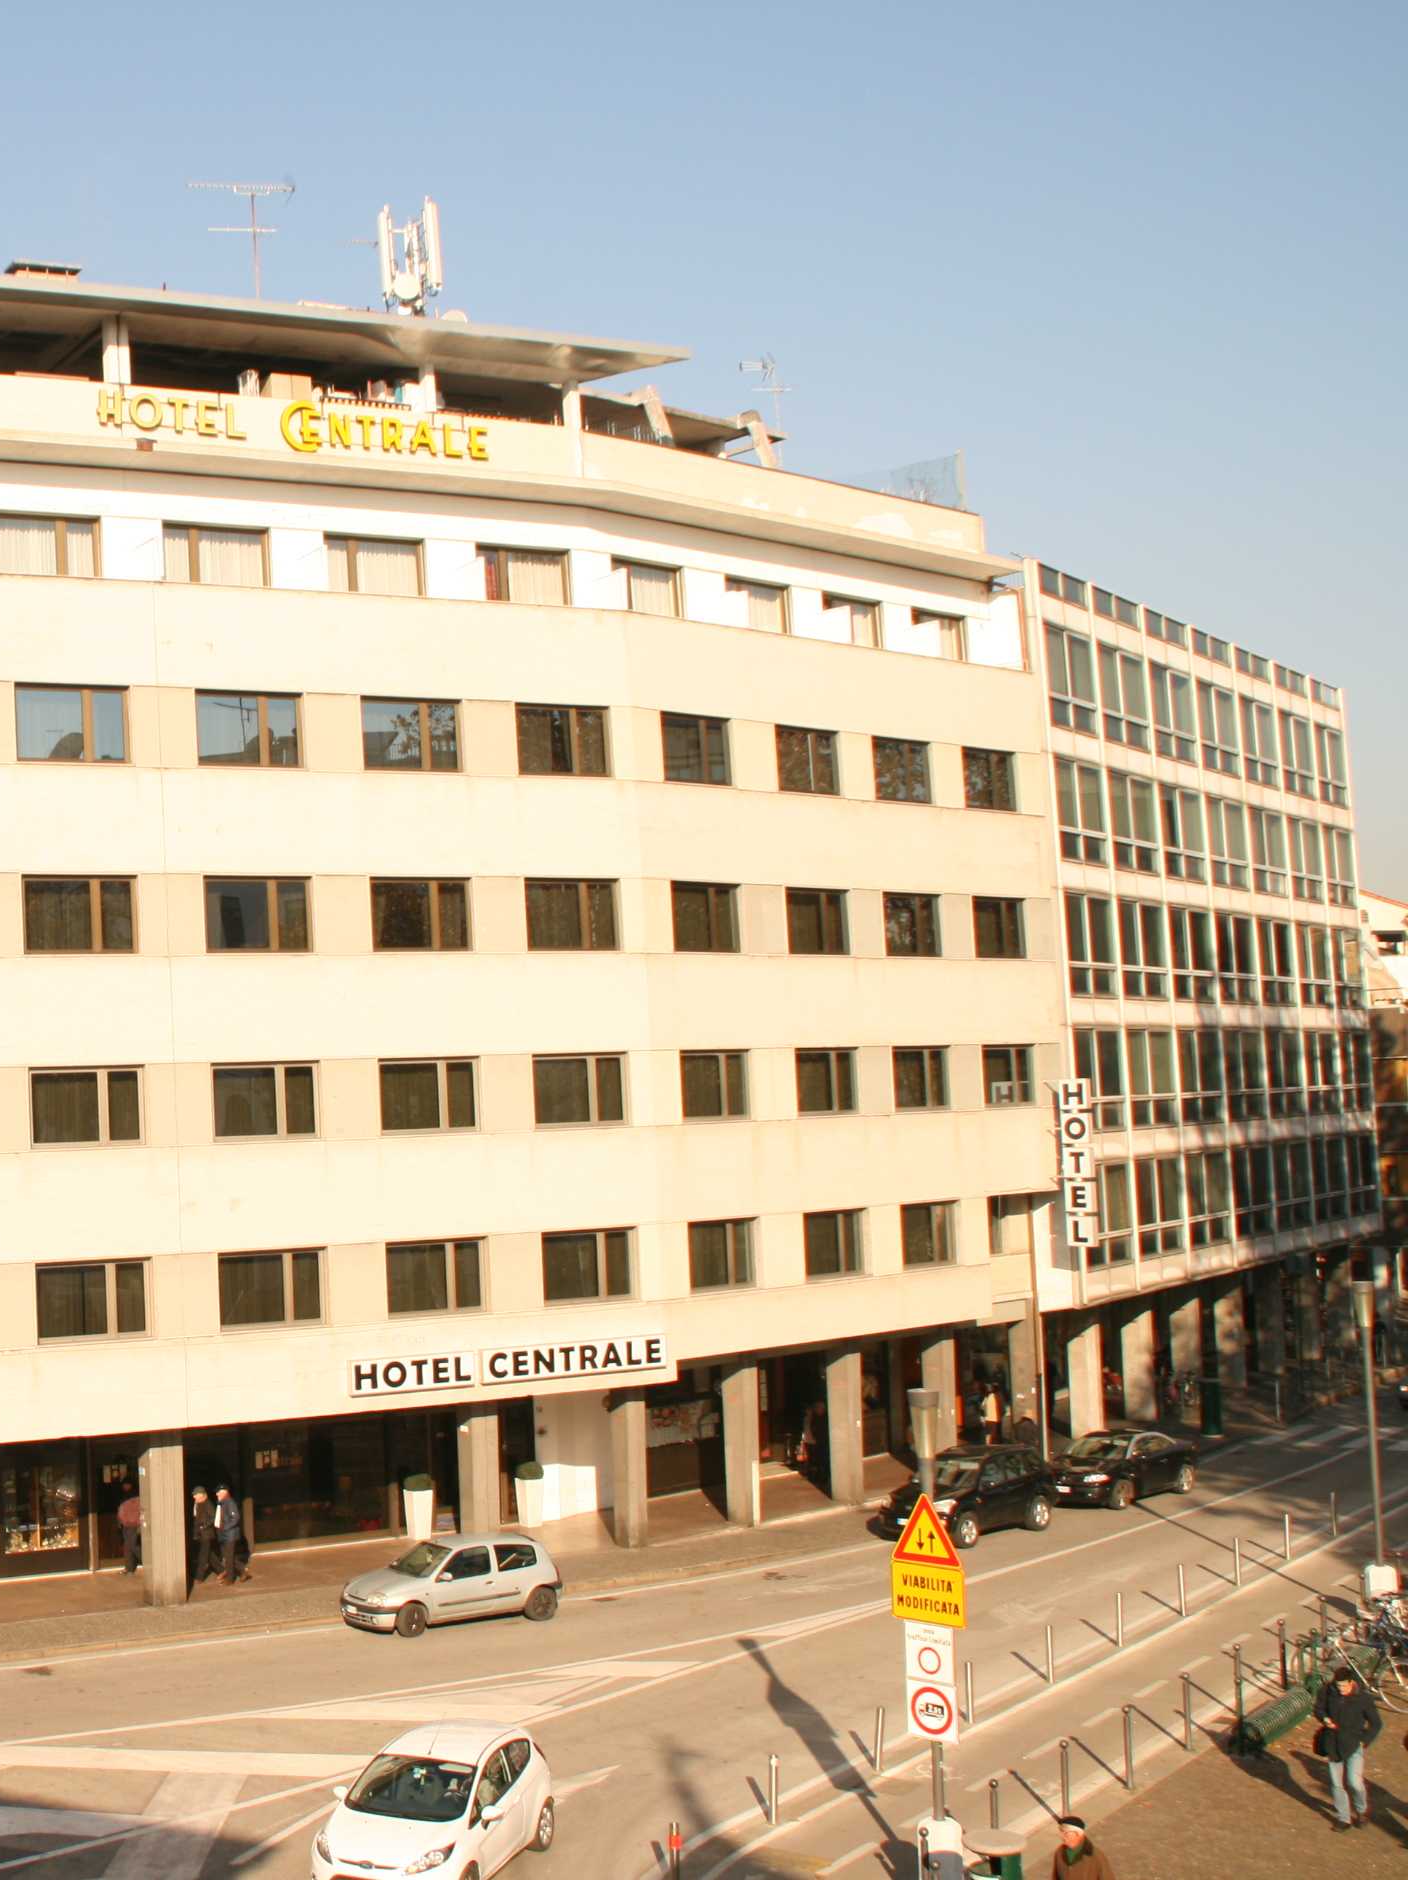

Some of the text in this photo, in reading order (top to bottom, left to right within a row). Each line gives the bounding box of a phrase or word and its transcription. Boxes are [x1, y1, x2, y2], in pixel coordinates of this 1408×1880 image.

[96, 389, 489, 461] HOTEL CENTRALE
[1062, 1083, 1089, 1243] HOTEL
[354, 1338, 662, 1391] HOTEL CENTRALE
[897, 1594, 960, 1616] MODIFICATA
